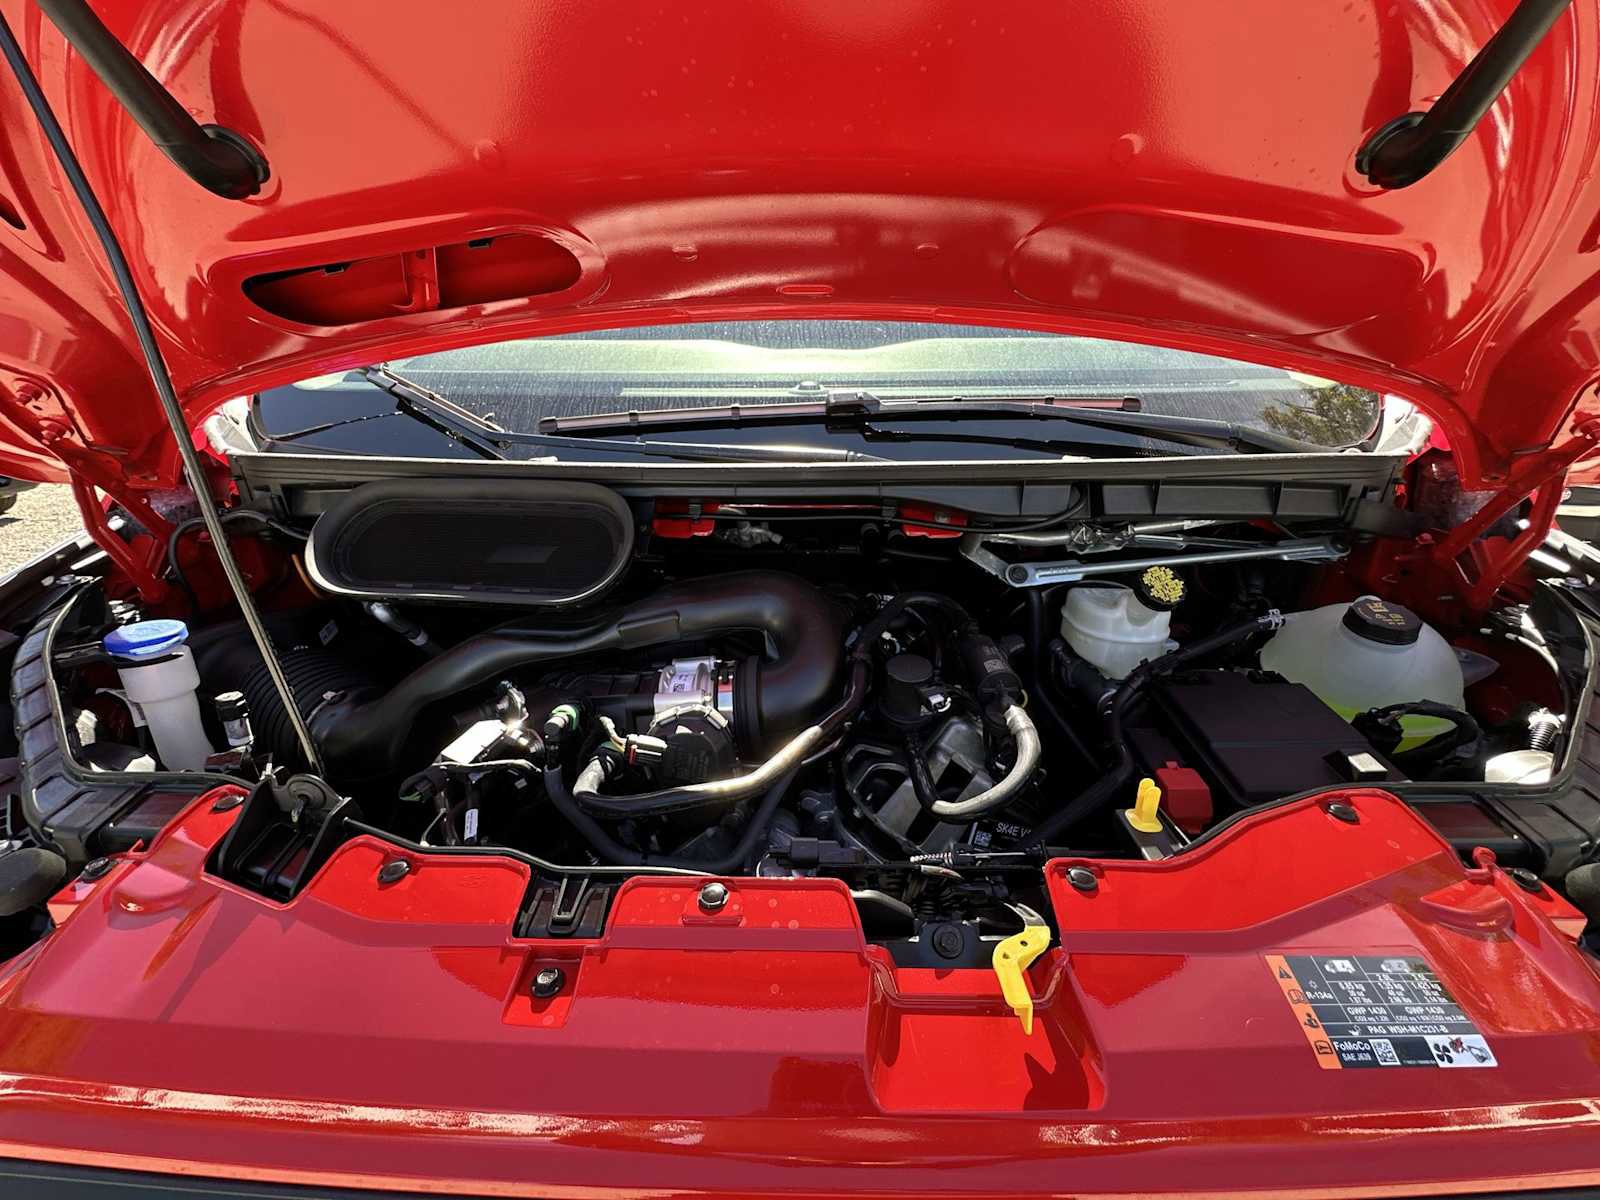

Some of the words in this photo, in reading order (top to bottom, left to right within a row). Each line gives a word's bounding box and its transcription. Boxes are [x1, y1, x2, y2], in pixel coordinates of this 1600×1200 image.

[1305, 991, 1334, 1000] R-134a
[1346, 1006, 1367, 1015] GWP
[1367, 1006, 1388, 1015] 1430
[1404, 1006, 1424, 1015] GWP
[1424, 1006, 1445, 1015] 1430
[1366, 1025, 1387, 1034] PAG
[1333, 1041, 1371, 1051] FoMoCo
